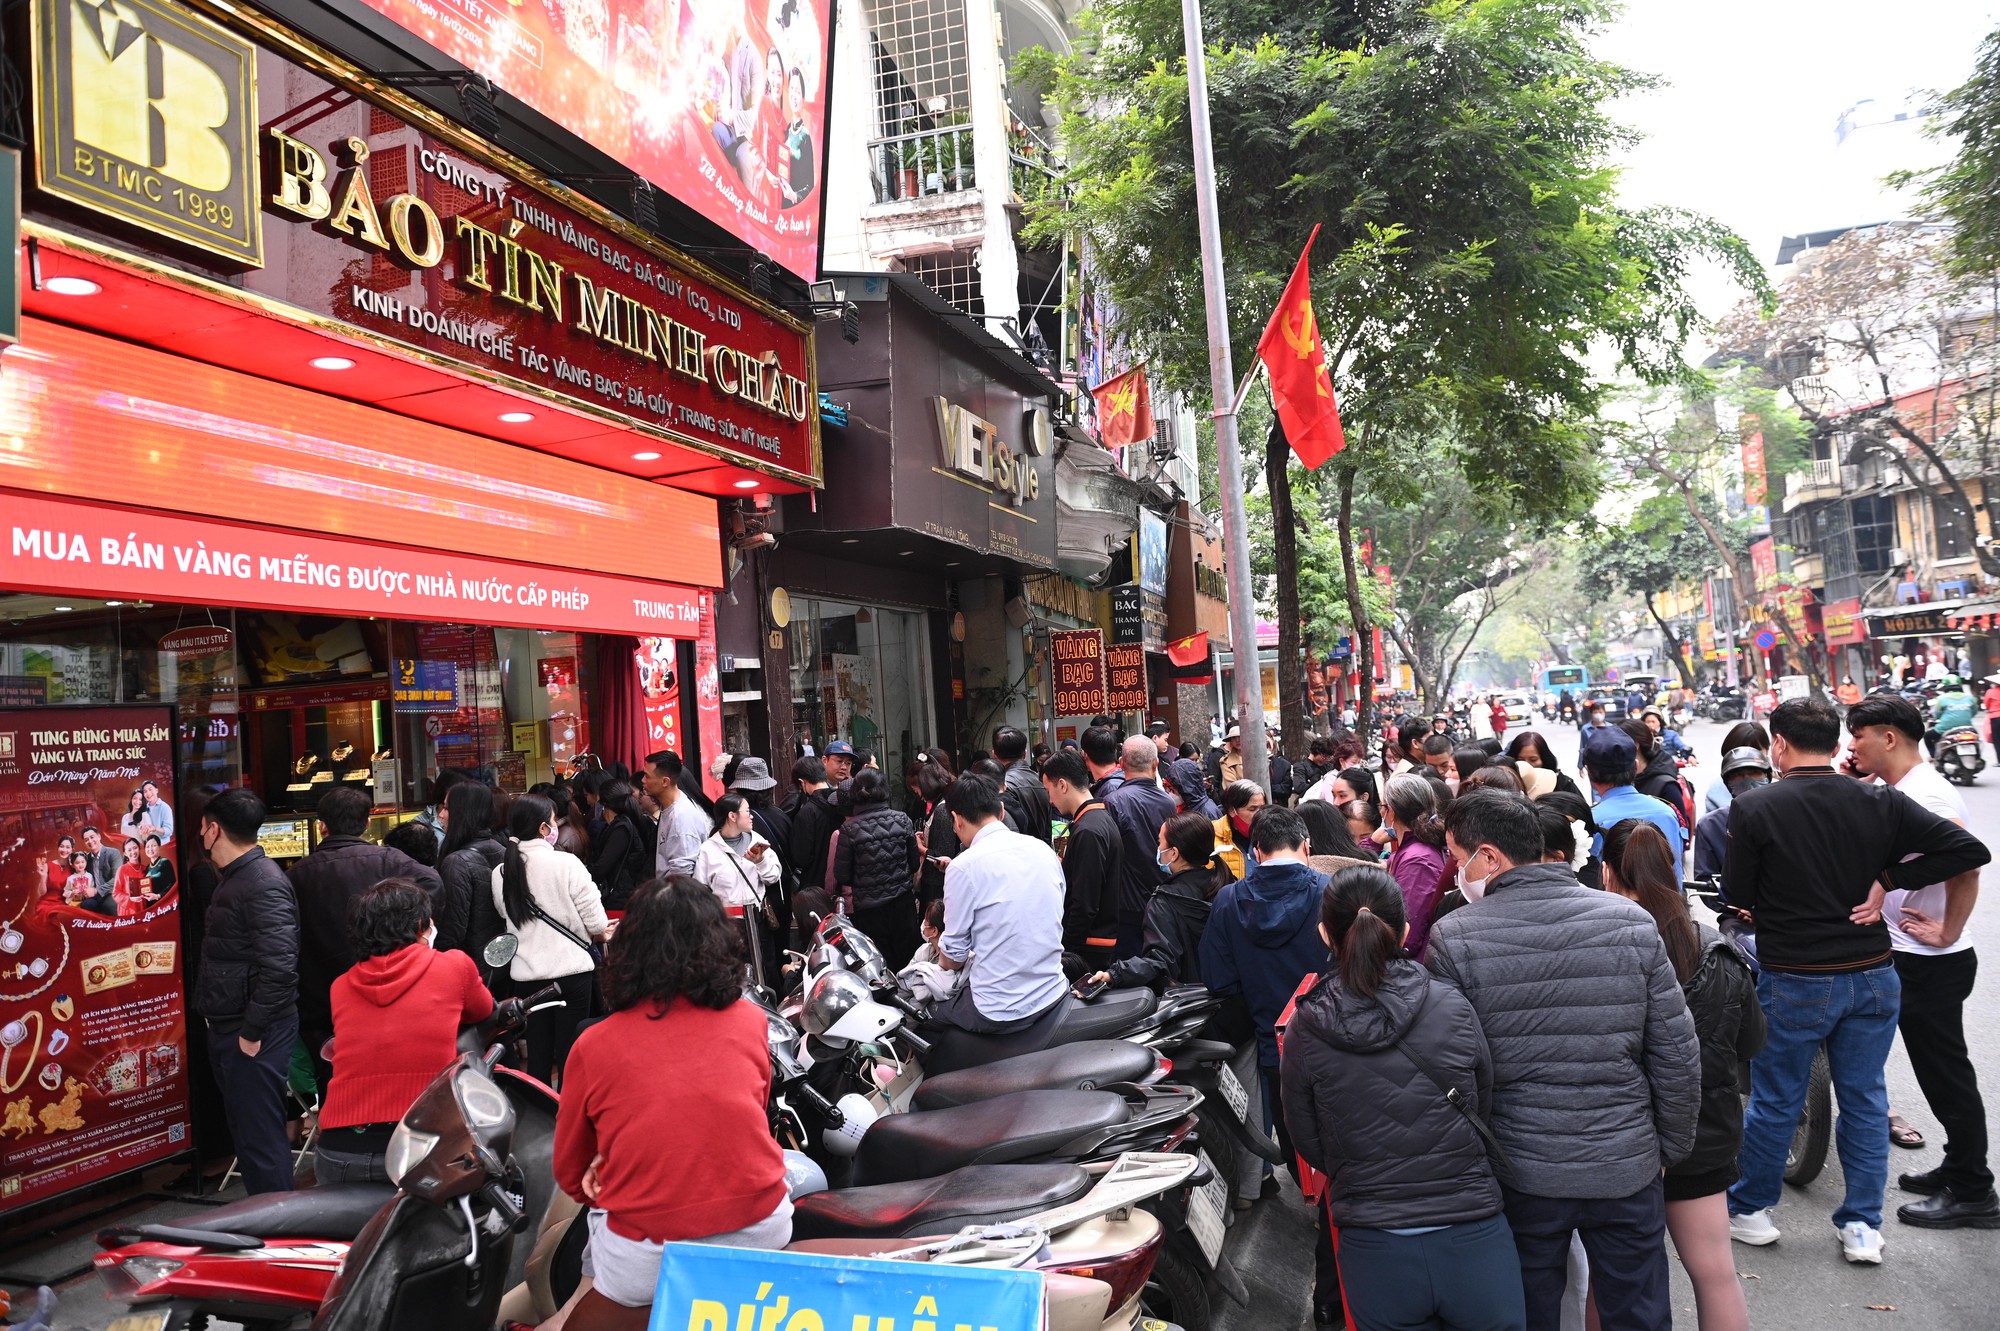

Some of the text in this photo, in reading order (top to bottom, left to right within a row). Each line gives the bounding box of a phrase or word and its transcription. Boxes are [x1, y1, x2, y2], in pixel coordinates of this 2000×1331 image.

[439, 9, 484, 48] 16/02/2026
[74, 146, 234, 231] BTMC 1989
[699, 156, 811, 236] Tết trưởng thành Lộc trọn ý
[420, 150, 480, 196] CÔNG
[483, 183, 507, 209] TY
[512, 197, 557, 236] TNHH
[559, 220, 599, 257] VÀNG
[602, 244, 632, 273] BẠC
[634, 262, 655, 286] ĐÁ
[656, 273, 683, 300] QUÝ
[718, 305, 742, 331] LTD)
[270, 128, 807, 422] BẢO TÍN MINH CHÂU
[352, 285, 402, 322] KINH
[408, 305, 475, 347] DOANH
[479, 333, 517, 362] CHẾ
[519, 345, 549, 373] TÁC
[553, 356, 591, 388] VÀNG
[628, 386, 646, 408] ĐÁ
[679, 405, 716, 432] TRANG
[718, 418, 739, 440] SỨC
[741, 428, 754, 446] MỸ
[757, 436, 781, 458] NGHỆ
[12, 527, 91, 563] MUA
[101, 533, 164, 570] BÁN
[173, 541, 251, 579] VÀNG
[347, 565, 410, 599] ĐƯỢC
[416, 572, 457, 599] NHÀ
[462, 576, 513, 605] NƯỚC
[551, 587, 590, 611] PHÉP
[633, 599, 700, 622] TRUNG TÂM
[1115, 600, 1138, 612] BẠC
[1121, 628, 1135, 636] SỨC
[1885, 616, 1934, 632] MODEL
[163, 633, 229, 650] VÀNG MÀU ITALY STYLE
[772, 634, 781, 646] 17
[1056, 635, 1098, 659] VÀNG
[724, 656, 733, 670] 17
[1107, 648, 1140, 667] VÀNG
[1062, 662, 1094, 687] BẠC
[1113, 669, 1138, 689] BẠC
[1058, 689, 1101, 711] 9999
[1110, 690, 1144, 708] 9999
[30, 730, 69, 746] TƯNG
[73, 727, 110, 745] BỪNG
[113, 728, 141, 743] MUA
[144, 723, 170, 742] SẮM
[31, 745, 147, 765] VÀNG VÀ TRANG SỨC
[28, 766, 140, 785] Đón Mừng Năm Mới
[72, 899, 178, 930] Tết trưởng thành Lộc trọn ý
[9, 1152, 25, 1161] TRAO
[52, 1138, 69, 1148] VÀNG
[72, 1134, 86, 1142] KHAI
[87, 1127, 103, 1137] XUÂN
[104, 1123, 119, 1132] SANG
[119, 1119, 131, 1128] QUÝ
[135, 1114, 147, 1123] ĐÓN
[148, 1110, 157, 1118] TẾT
[166, 1104, 184, 1113] KHANG
